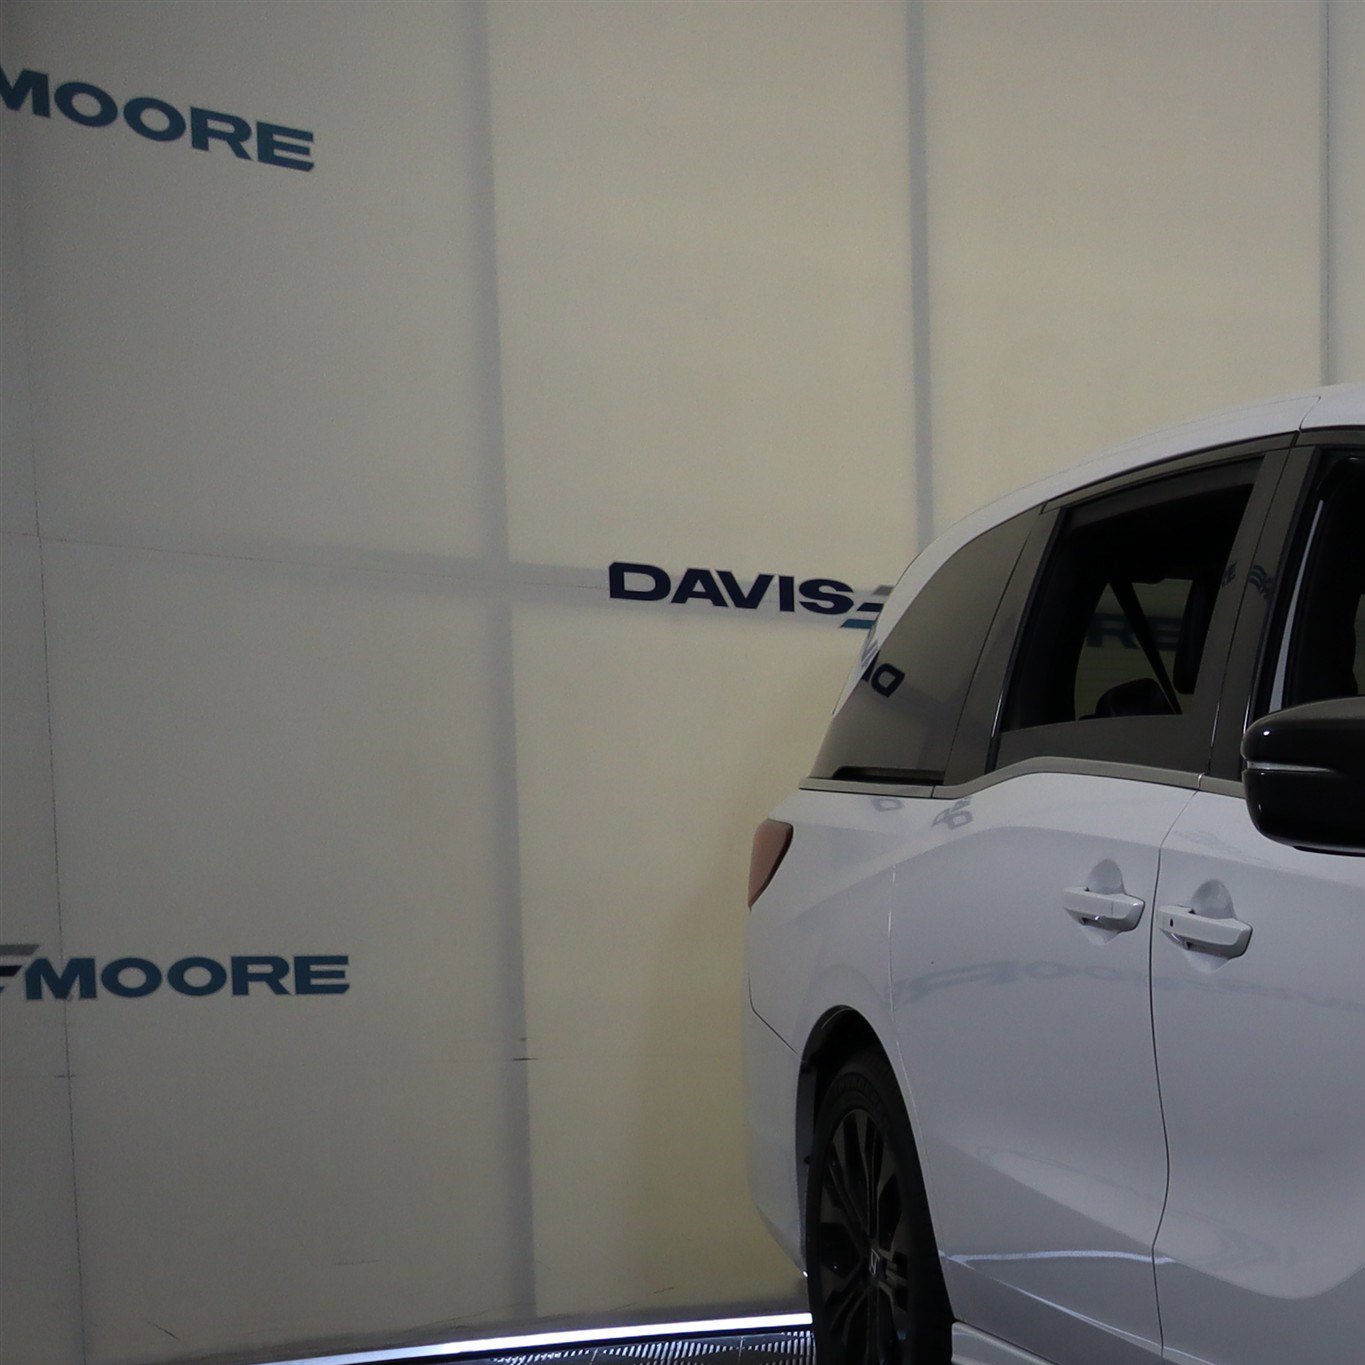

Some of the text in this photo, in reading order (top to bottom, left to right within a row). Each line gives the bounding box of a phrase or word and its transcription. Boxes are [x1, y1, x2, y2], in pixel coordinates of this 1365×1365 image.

[0, 66, 315, 172] MOORE
[608, 561, 855, 616] DAVIS
[24, 955, 350, 1001] MOORE
